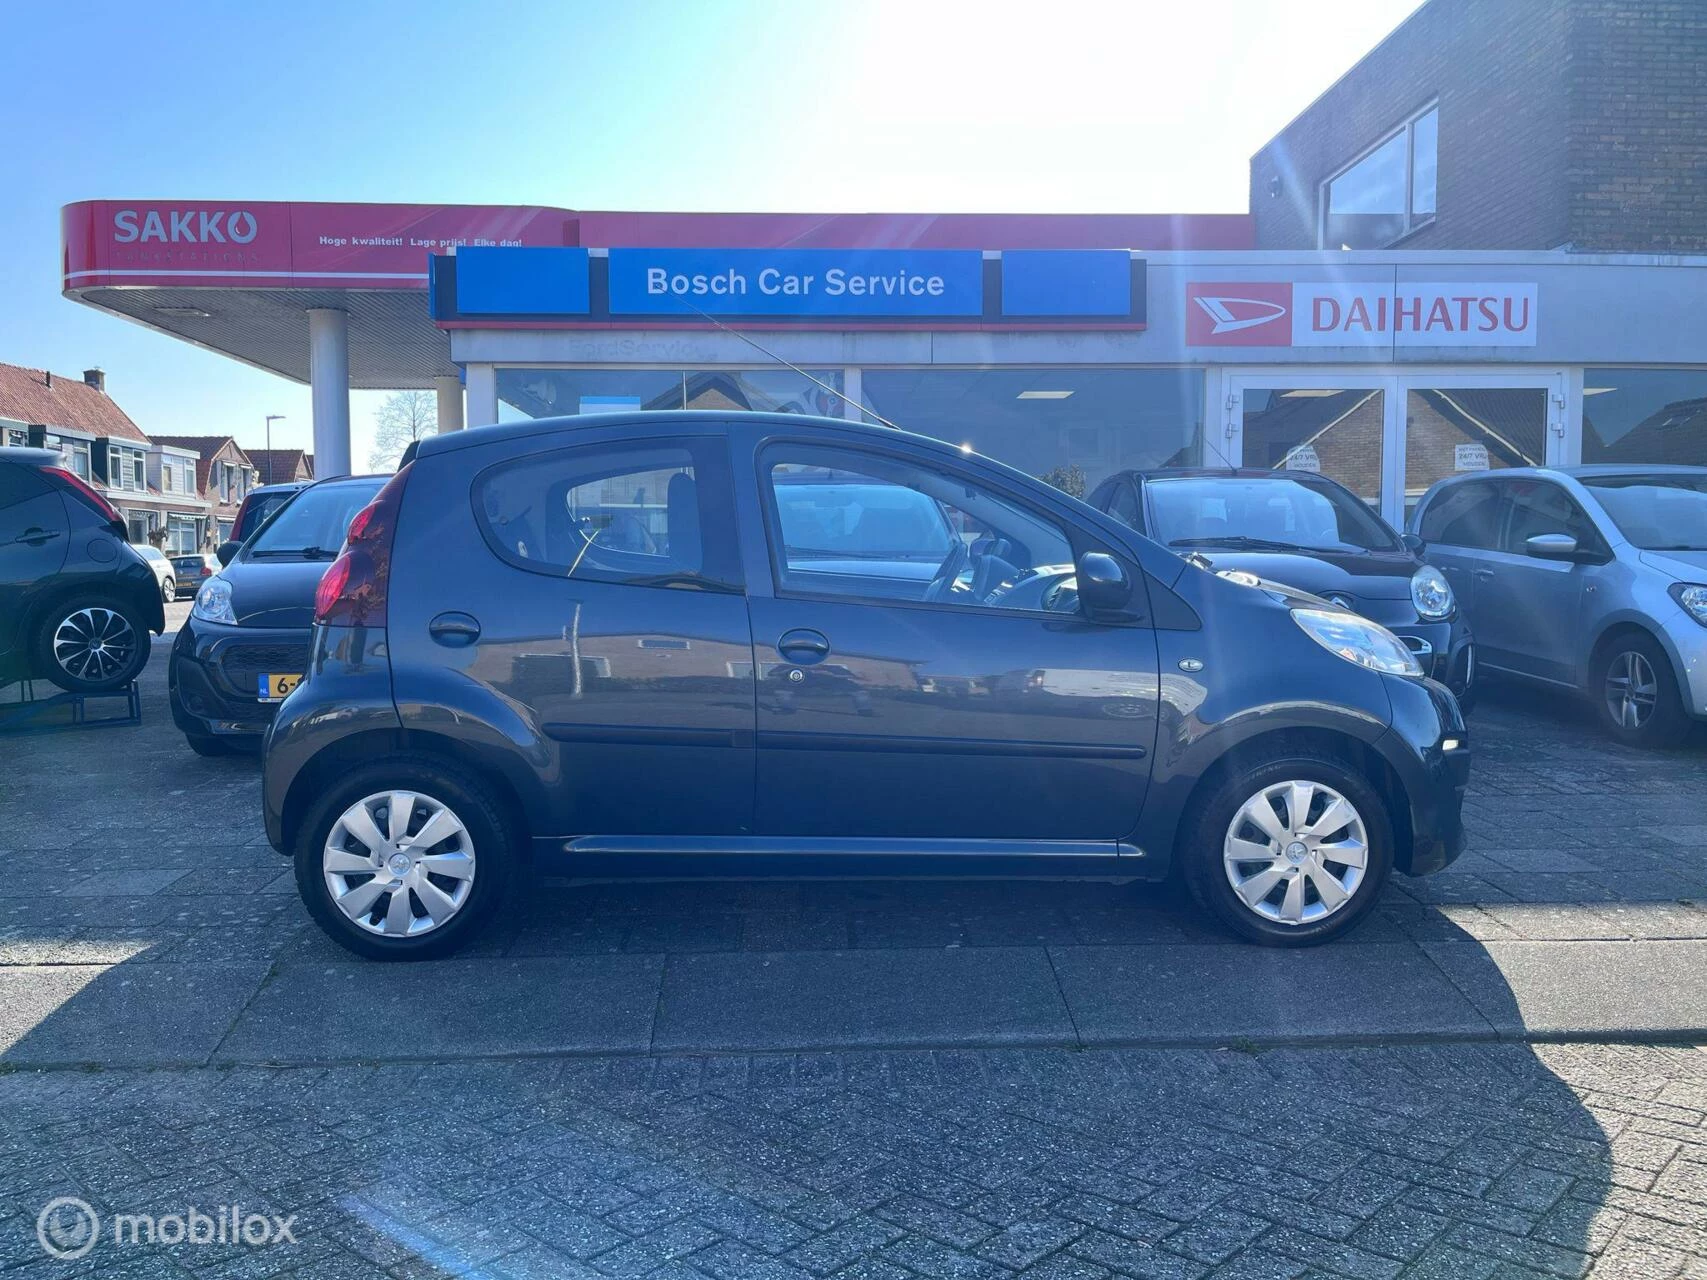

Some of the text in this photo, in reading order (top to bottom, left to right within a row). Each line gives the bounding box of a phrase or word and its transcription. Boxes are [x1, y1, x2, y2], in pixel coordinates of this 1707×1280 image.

[114, 210, 257, 243] SAKKO
[319, 236, 347, 247] Hoge
[352, 237, 403, 247] kwaliteit!
[410, 238, 437, 248] Lage
[440, 239, 466, 248] prijs!
[474, 239, 496, 247] Elke
[647, 268, 945, 296] Bosch Car Service
[1312, 297, 1529, 332] DAIHATSU
